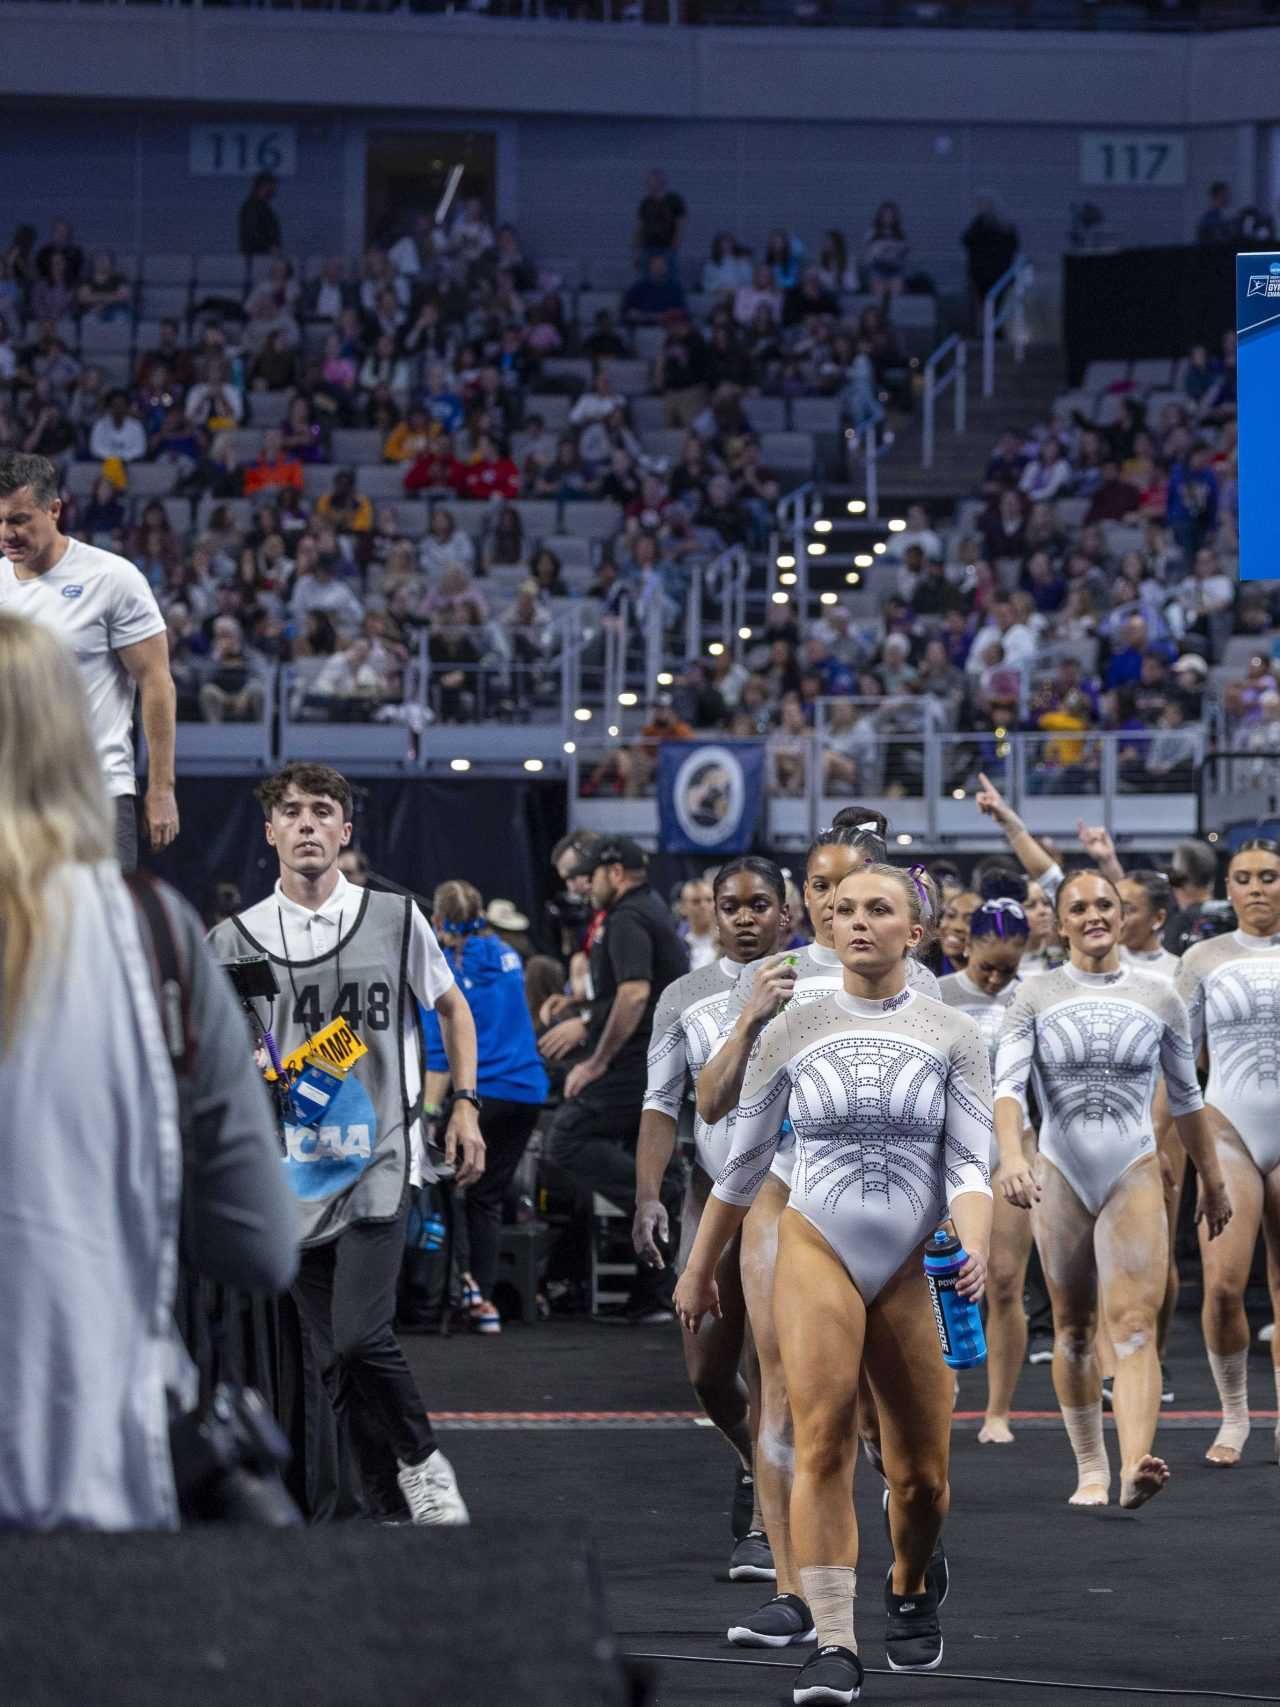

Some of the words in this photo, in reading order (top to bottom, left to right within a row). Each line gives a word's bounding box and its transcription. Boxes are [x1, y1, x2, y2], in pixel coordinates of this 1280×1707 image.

[210, 132, 281, 171] 116
[1100, 144, 1169, 179] 117
[293, 982, 390, 1031] 448
[926, 1274, 950, 1354] POWERADE
